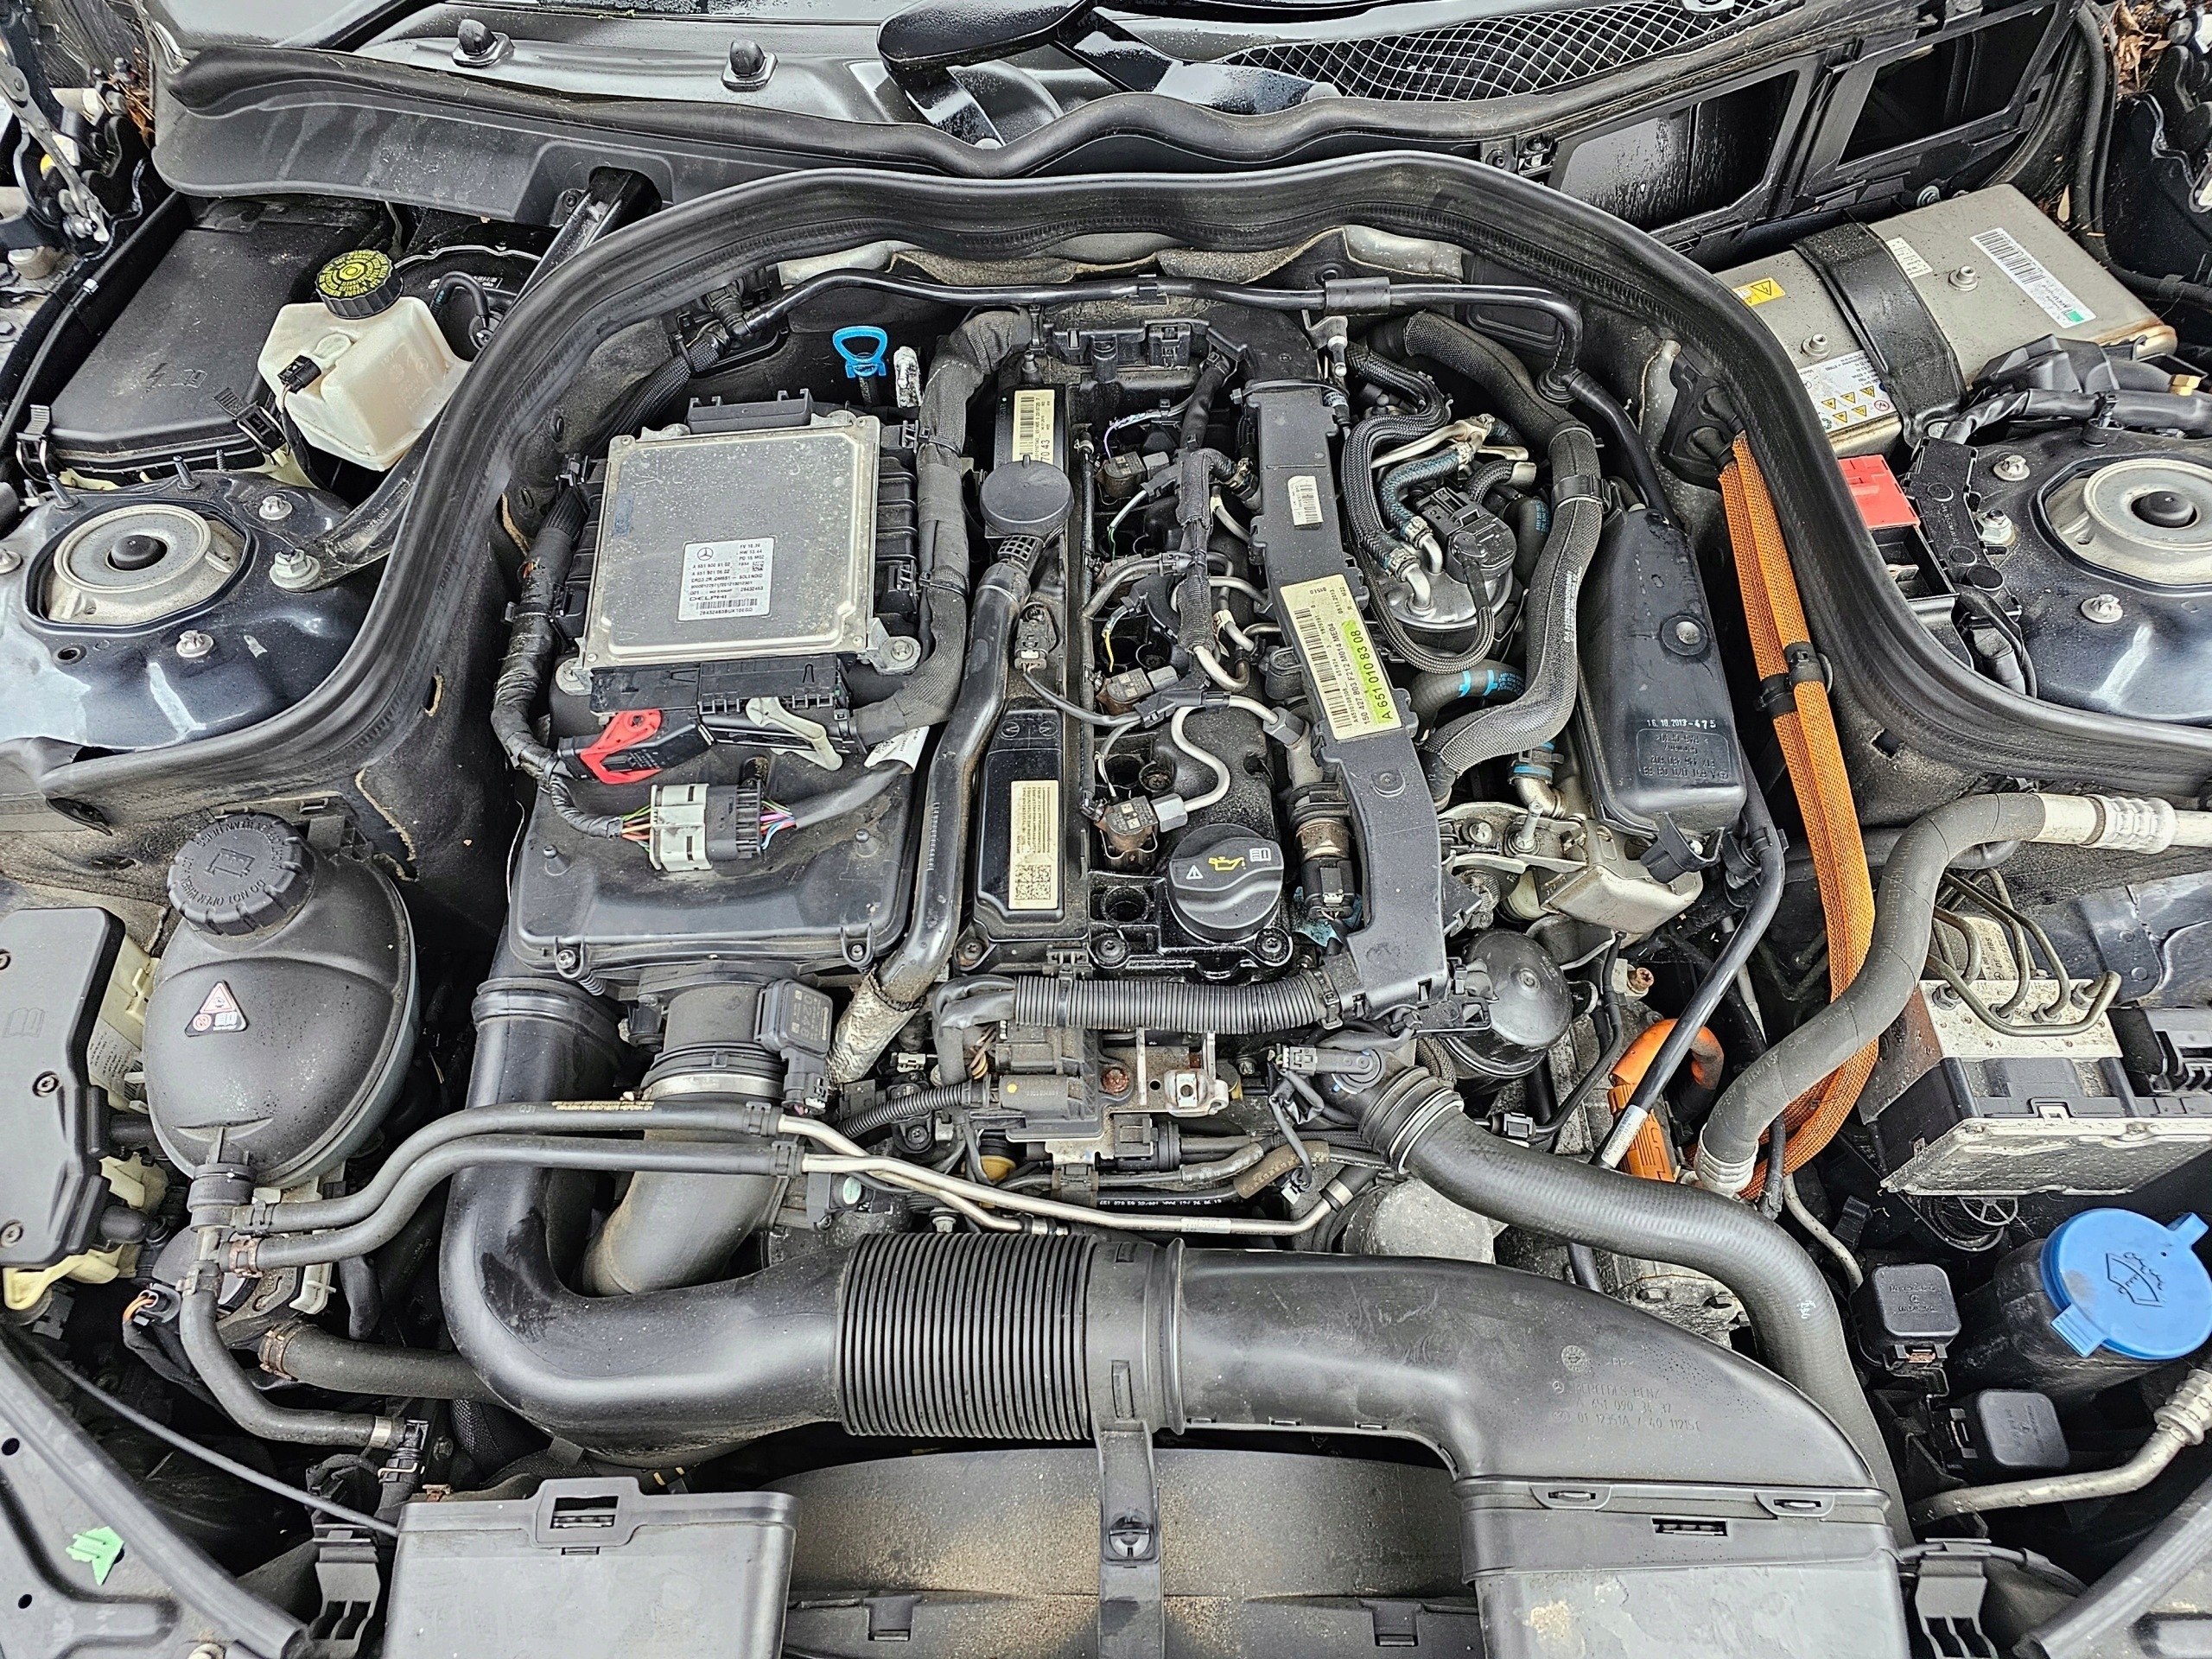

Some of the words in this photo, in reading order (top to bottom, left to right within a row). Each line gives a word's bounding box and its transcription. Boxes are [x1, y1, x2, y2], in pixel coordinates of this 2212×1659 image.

[1041, 439, 1050, 448] 43
[1328, 623, 1340, 641] ME04
[1351, 630, 1363, 643] 08
[1336, 643, 1347, 661] M014
[1357, 645, 1370, 660] 83
[1344, 663, 1355, 681] F212
[1363, 663, 1379, 683] 010
[1350, 682, 1360, 695] 803
[1356, 696, 1365, 709] 427
[1374, 687, 1388, 708] 651
[1361, 712, 1370, 724] 150
[1382, 710, 1393, 720] A
[250, 880, 266, 893] DO
[198, 894, 224, 906] OPEN
[228, 891, 249, 905] NOT
[1608, 1124, 1624, 1150] MERCEDES
[1623, 1112, 1631, 1124] BENZ
[1574, 1382, 1627, 1397] MERCEDES
[1633, 1387, 1661, 1399] BENZ
[1592, 1399, 1608, 1410] 651
[1614, 1402, 1633, 1411] 090
[1649, 1417, 1662, 1428] 40
